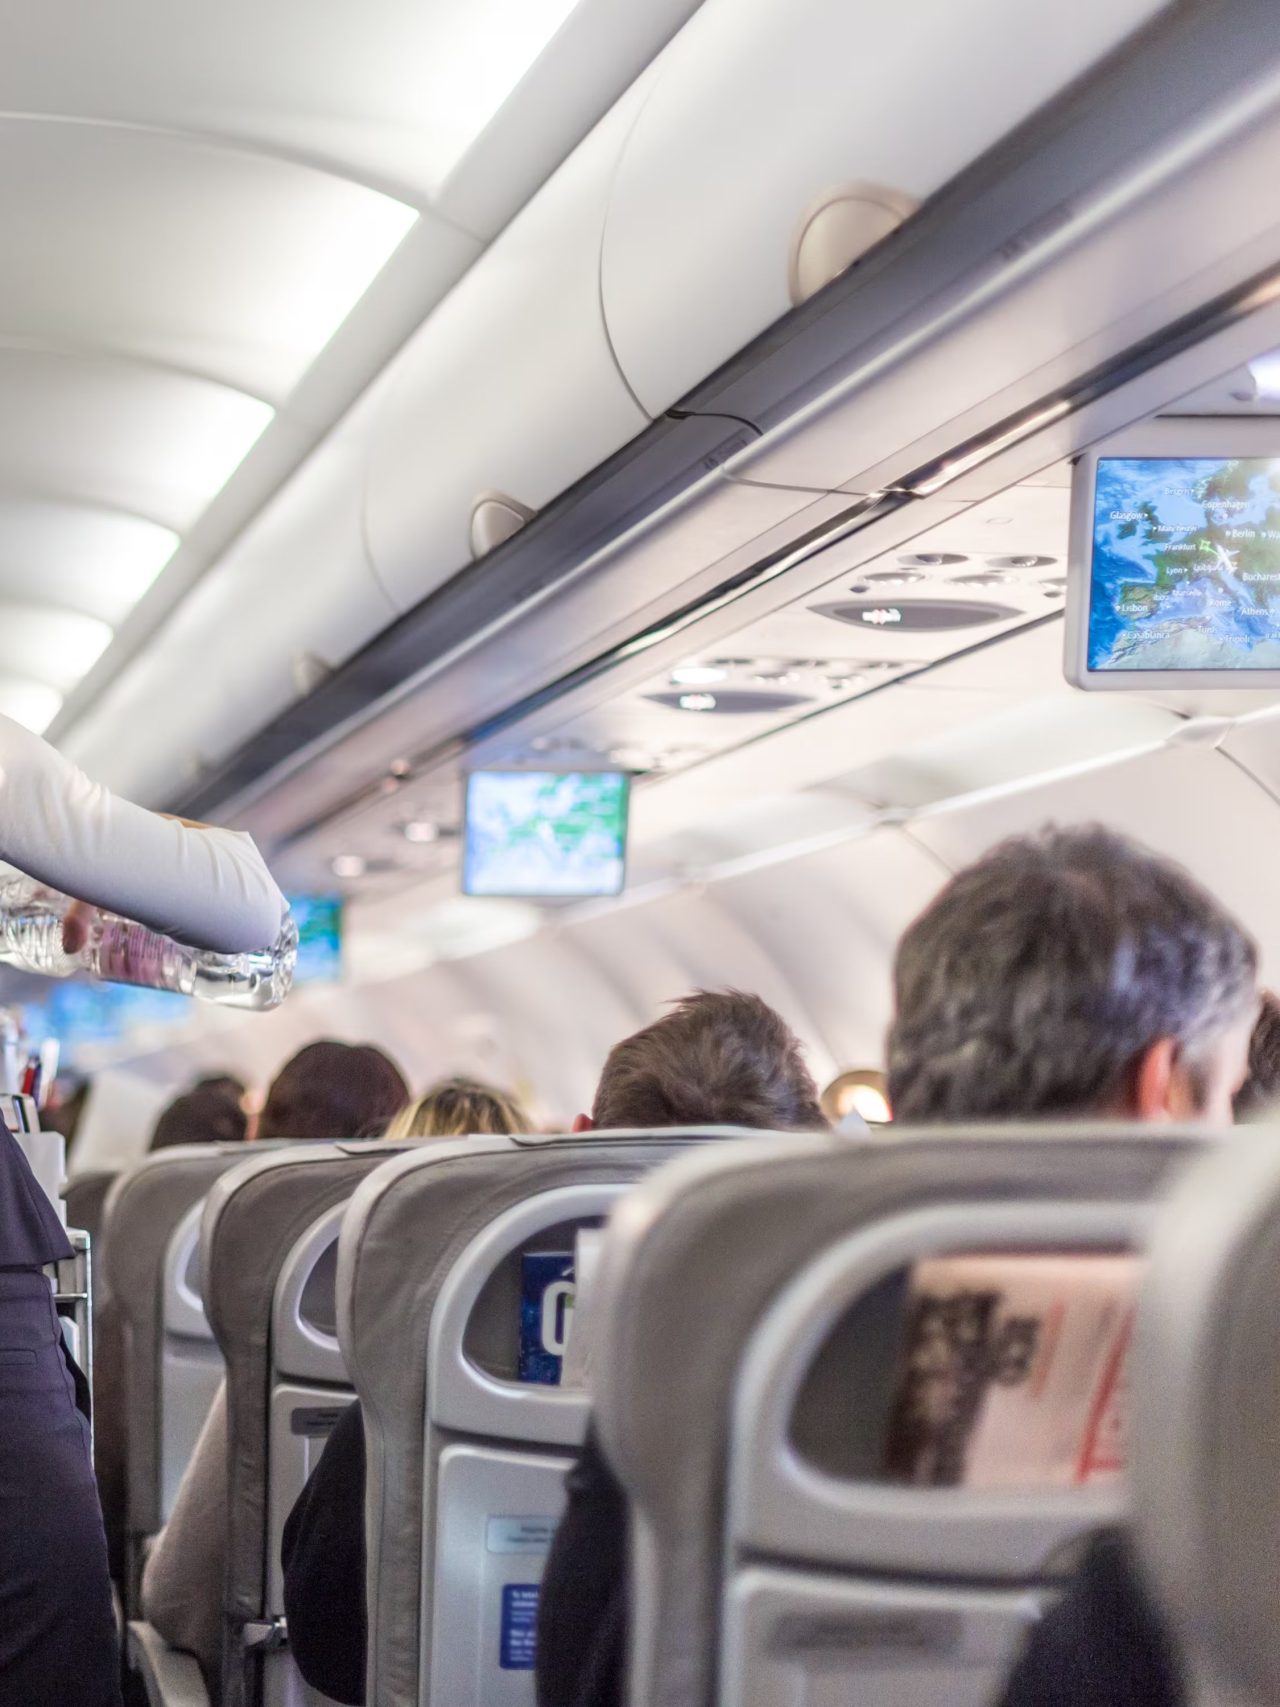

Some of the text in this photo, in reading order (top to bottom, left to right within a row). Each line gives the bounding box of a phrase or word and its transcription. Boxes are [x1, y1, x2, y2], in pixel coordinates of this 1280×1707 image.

[1110, 511, 1143, 521] Glasgow
[1232, 529, 1256, 538] Berlin
[1166, 566, 1183, 575] Lyon
[1122, 603, 1148, 612] Lisbon
